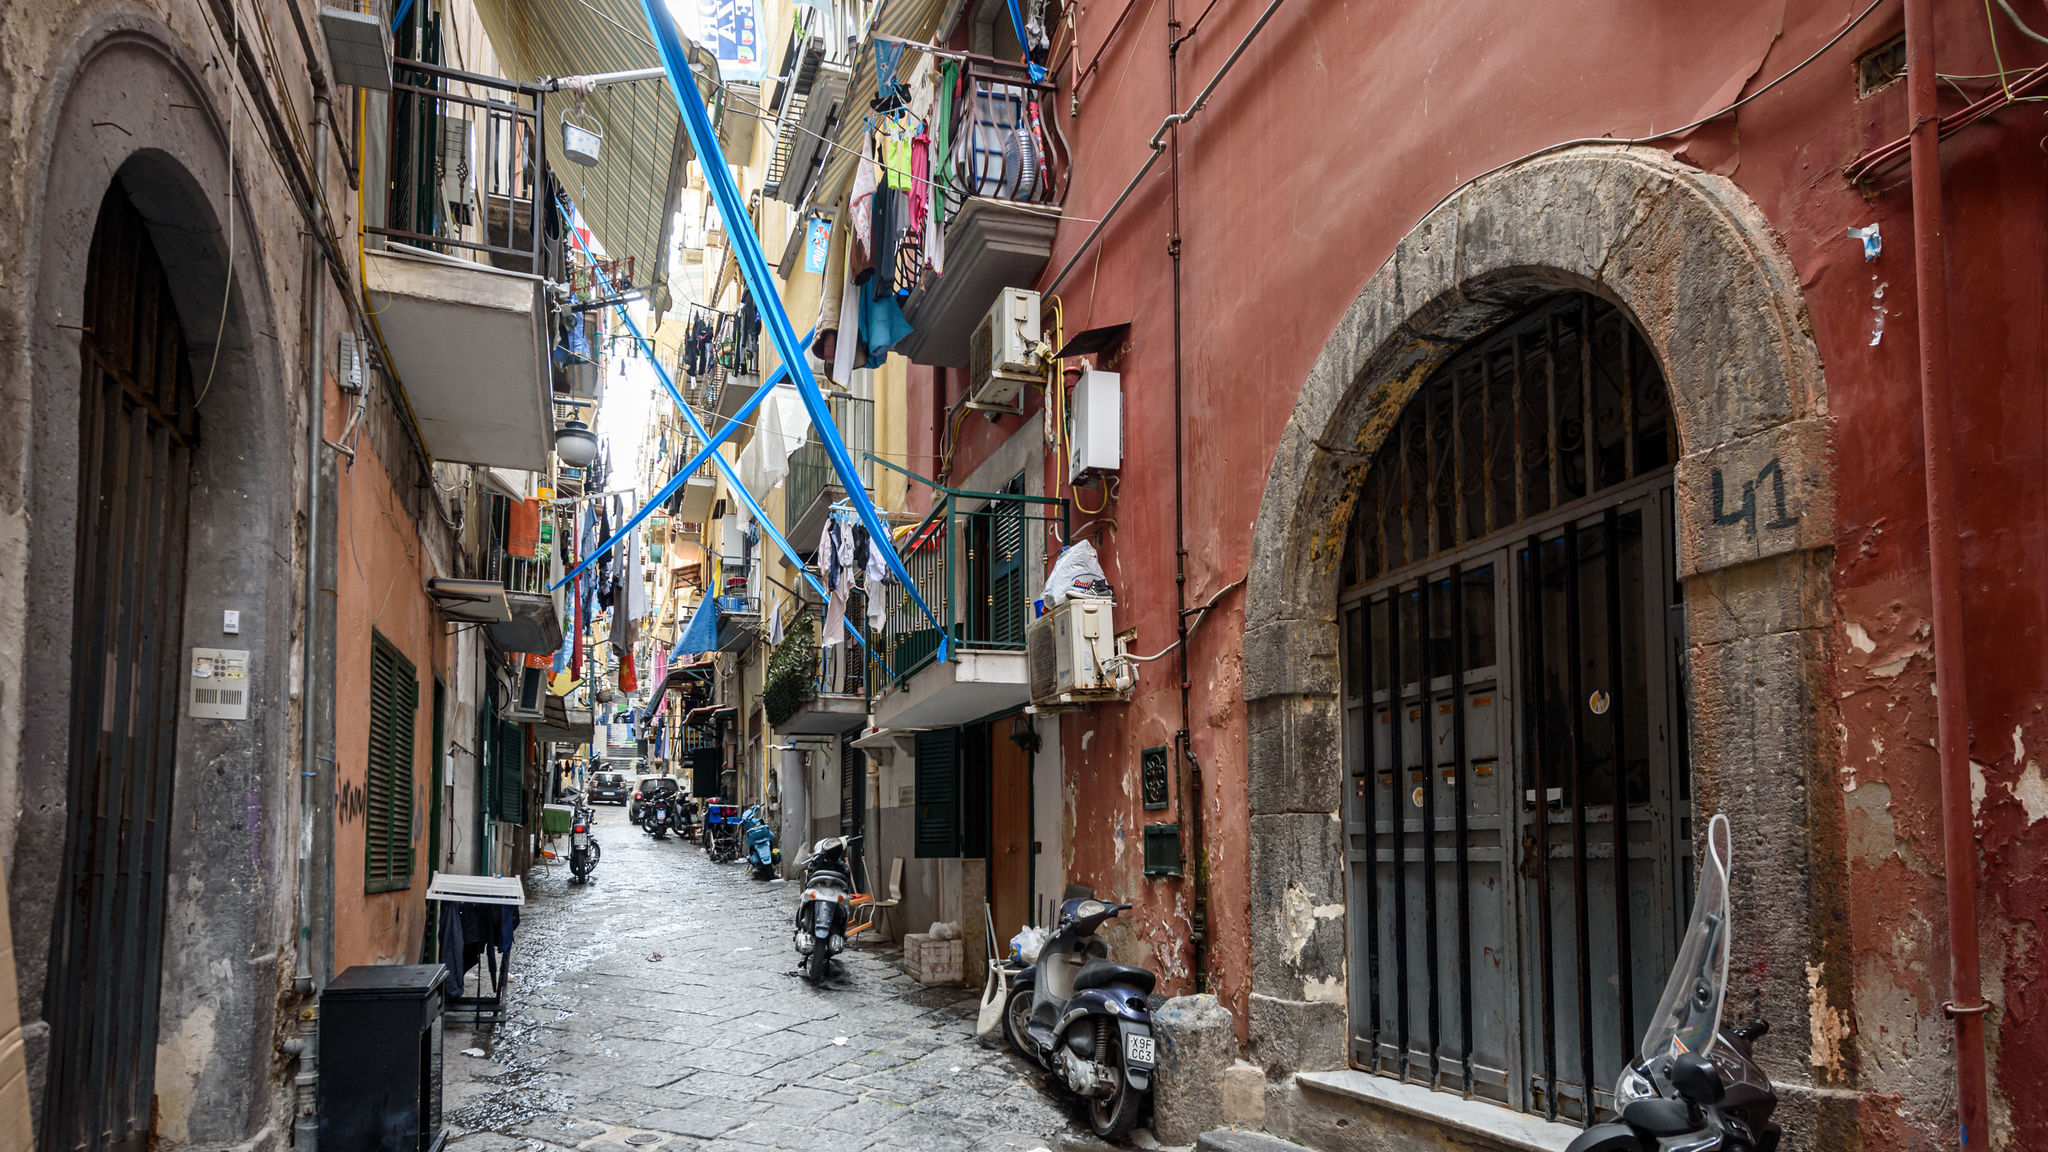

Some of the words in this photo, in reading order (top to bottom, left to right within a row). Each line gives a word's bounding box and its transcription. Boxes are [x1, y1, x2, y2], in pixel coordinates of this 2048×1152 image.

[1711, 457, 1799, 535] 41
[1132, 1036, 1152, 1050] X9F
[1131, 1048, 1152, 1061] CG3
